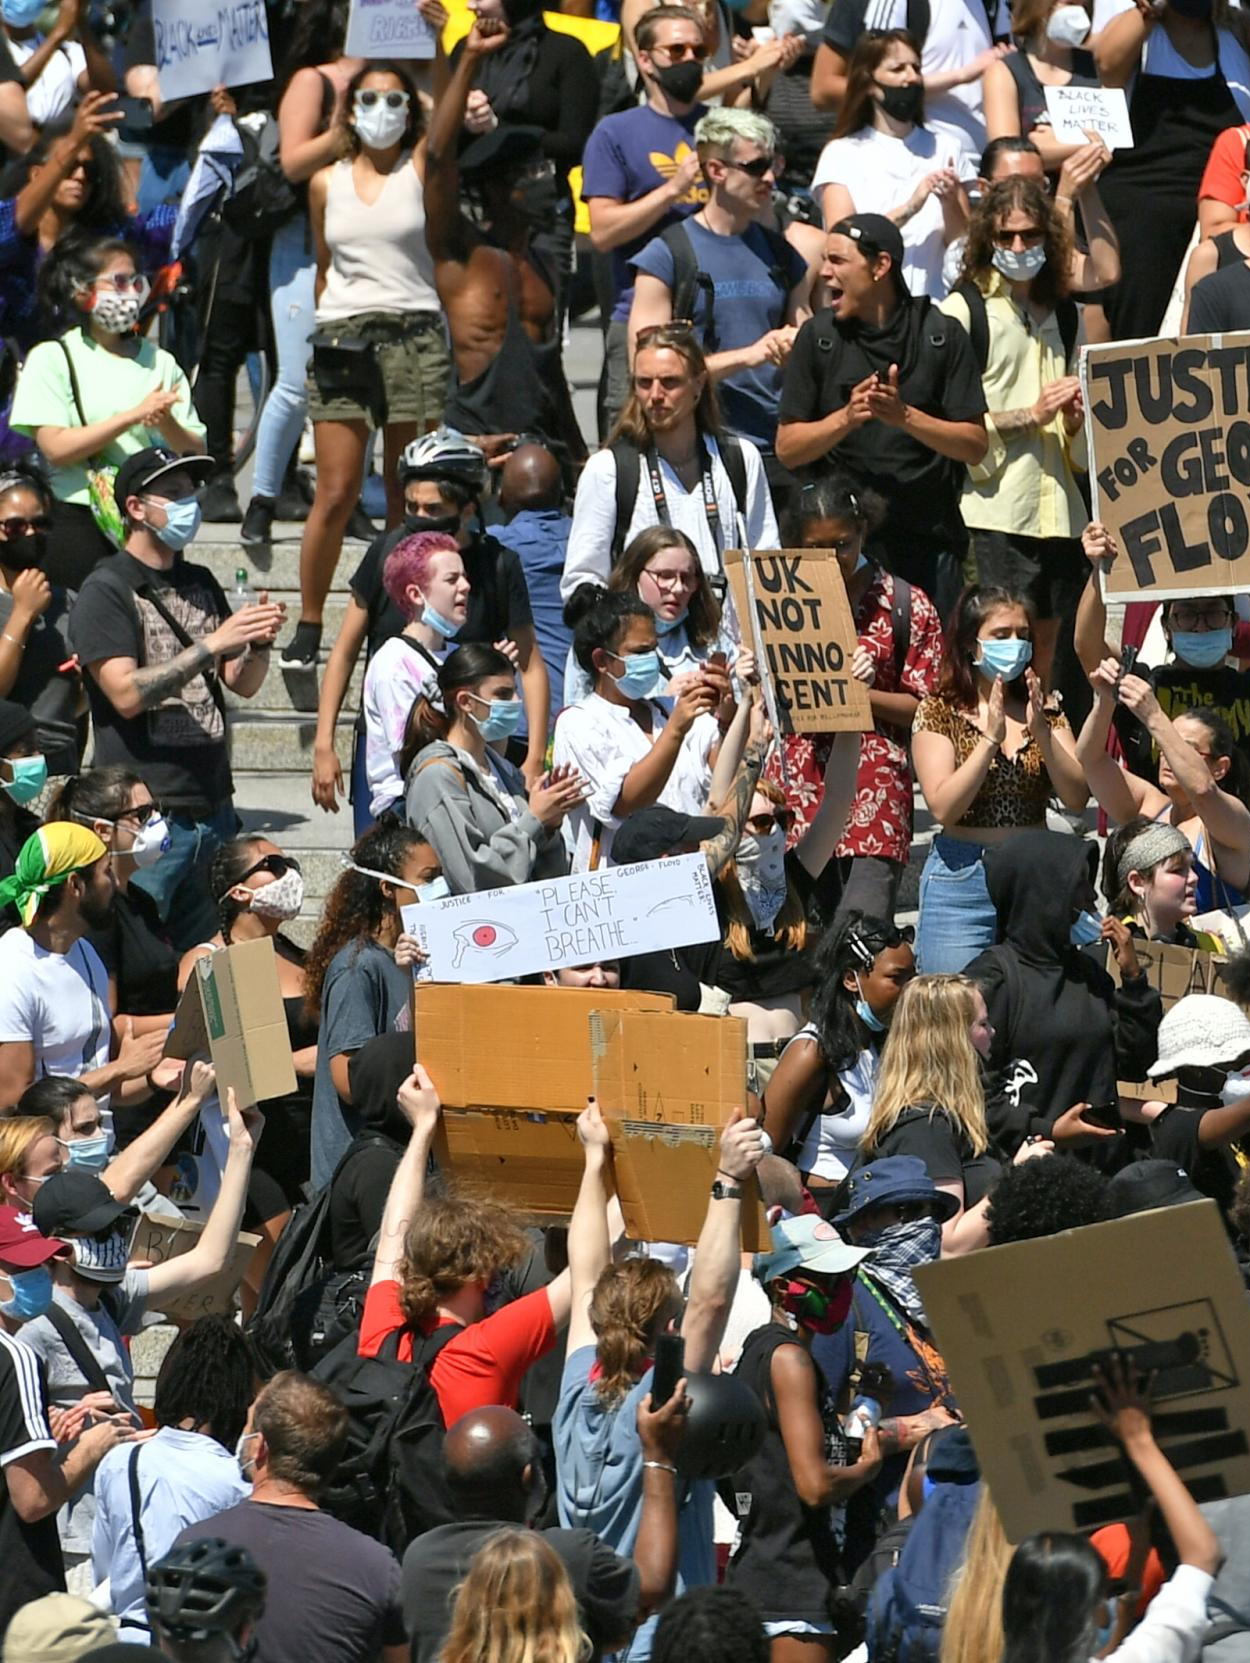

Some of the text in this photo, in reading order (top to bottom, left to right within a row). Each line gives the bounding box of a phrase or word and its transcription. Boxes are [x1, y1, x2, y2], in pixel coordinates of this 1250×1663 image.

[1057, 90, 1103, 103] BLACK
[1069, 105, 1109, 116] LIVES
[1062, 119, 1119, 132] MATTER
[1097, 437, 1157, 501] FOR
[754, 556, 814, 593] UK
[755, 597, 822, 632] NOT
[766, 641, 844, 674] INNO
[775, 678, 848, 710] CENT
[440, 896, 471, 910] JUSTICE
[617, 864, 649, 878] GEORGE
[658, 859, 681, 869] FLOYD
[539, 895, 614, 933] I CAN'T
